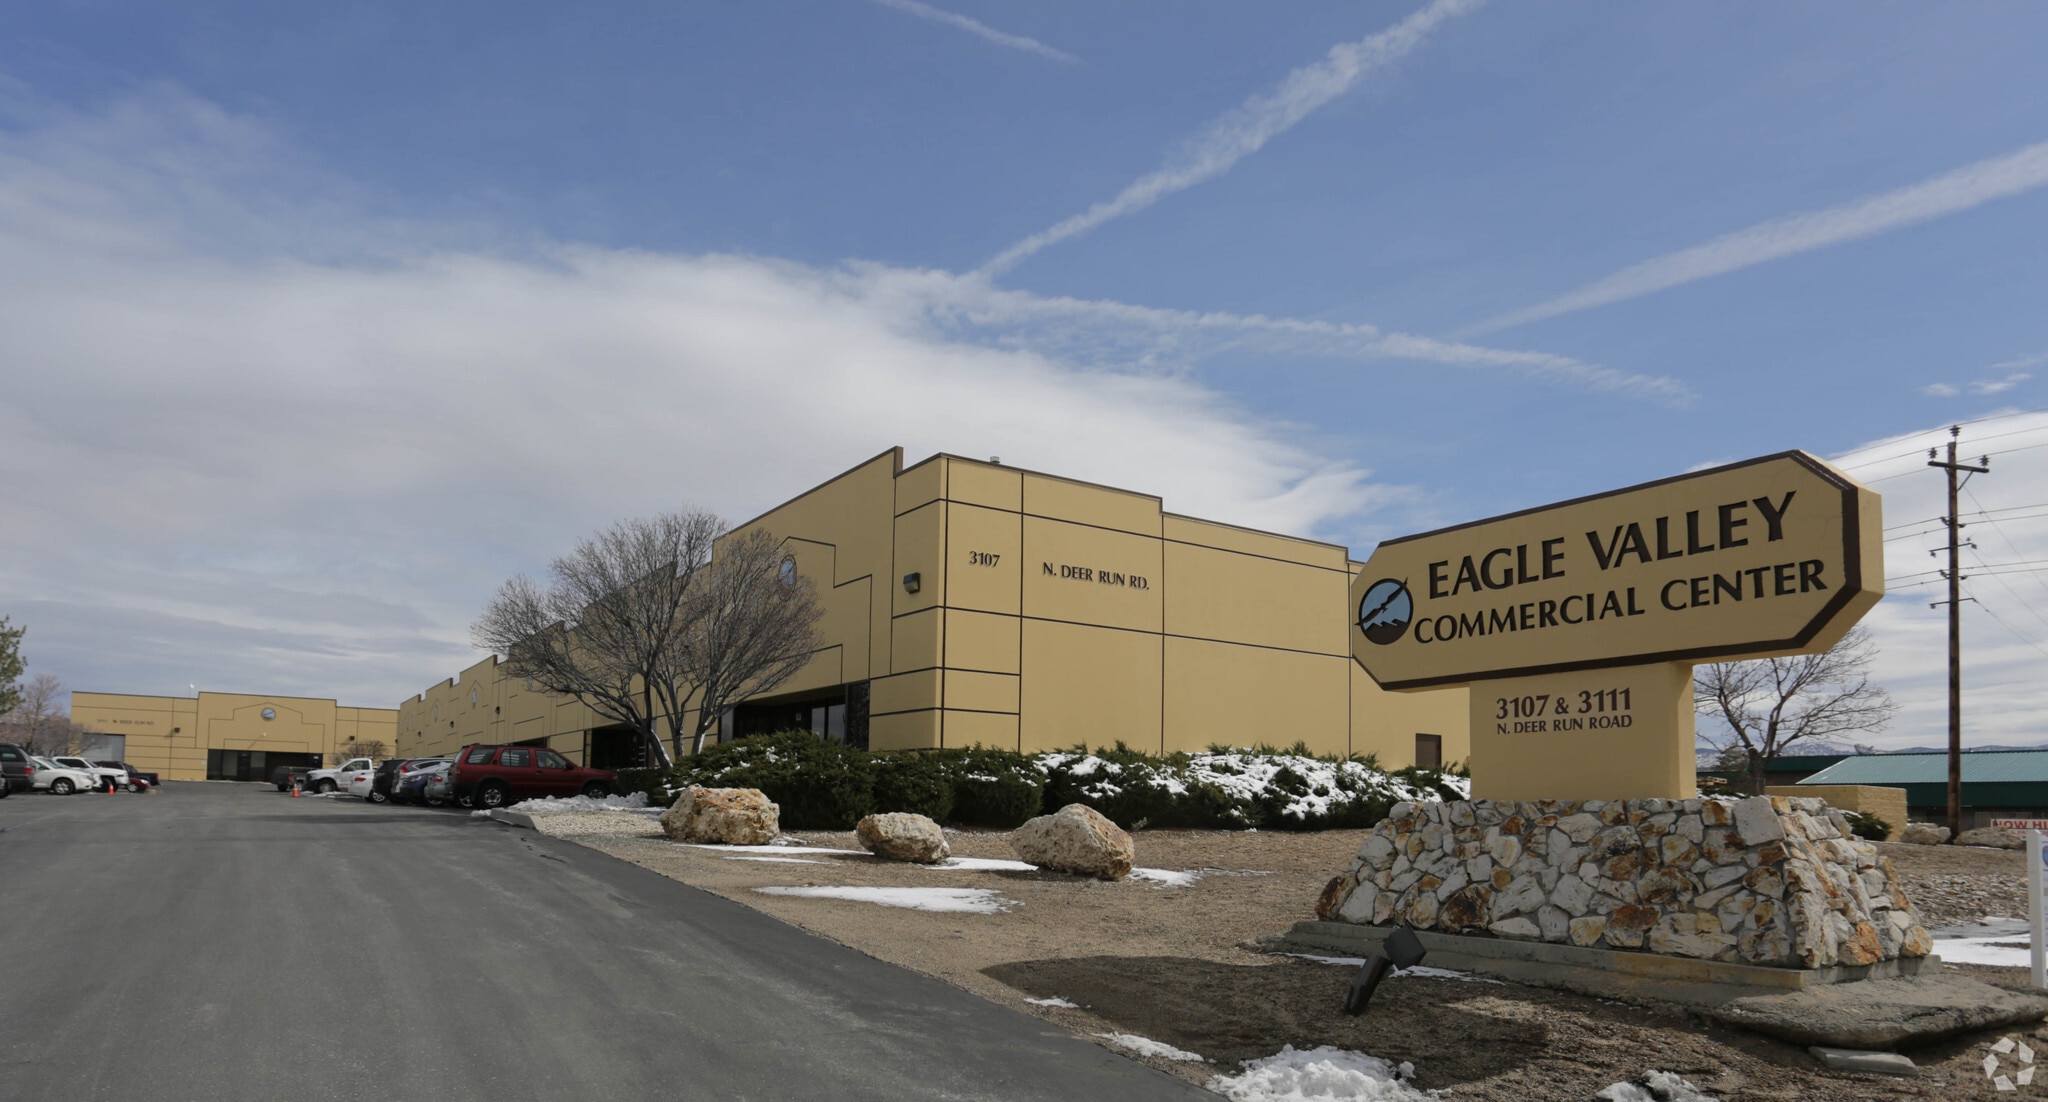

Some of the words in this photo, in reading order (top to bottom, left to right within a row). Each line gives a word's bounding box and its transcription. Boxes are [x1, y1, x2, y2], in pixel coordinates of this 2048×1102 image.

[969, 551, 1000, 567] 3107
[1428, 536, 1566, 600] EAGLE
[1586, 490, 1797, 571] VALLEY
[1043, 562, 1057, 576] N.
[1061, 564, 1094, 581] DEER
[1098, 570, 1126, 587] RUN
[1129, 575, 1150, 590] RD.
[1414, 587, 1646, 644] COMMERCIAL
[1660, 559, 1828, 612] CENTER
[1496, 694, 1550, 719] 3107
[1554, 697, 1569, 715] &
[1577, 687, 1631, 714] 3111
[1497, 723, 1511, 735] N.
[1514, 720, 1547, 733] DEER
[1553, 718, 1583, 732] RUN
[1589, 714, 1632, 729] ROAD
[1992, 820, 2028, 829] NOW
